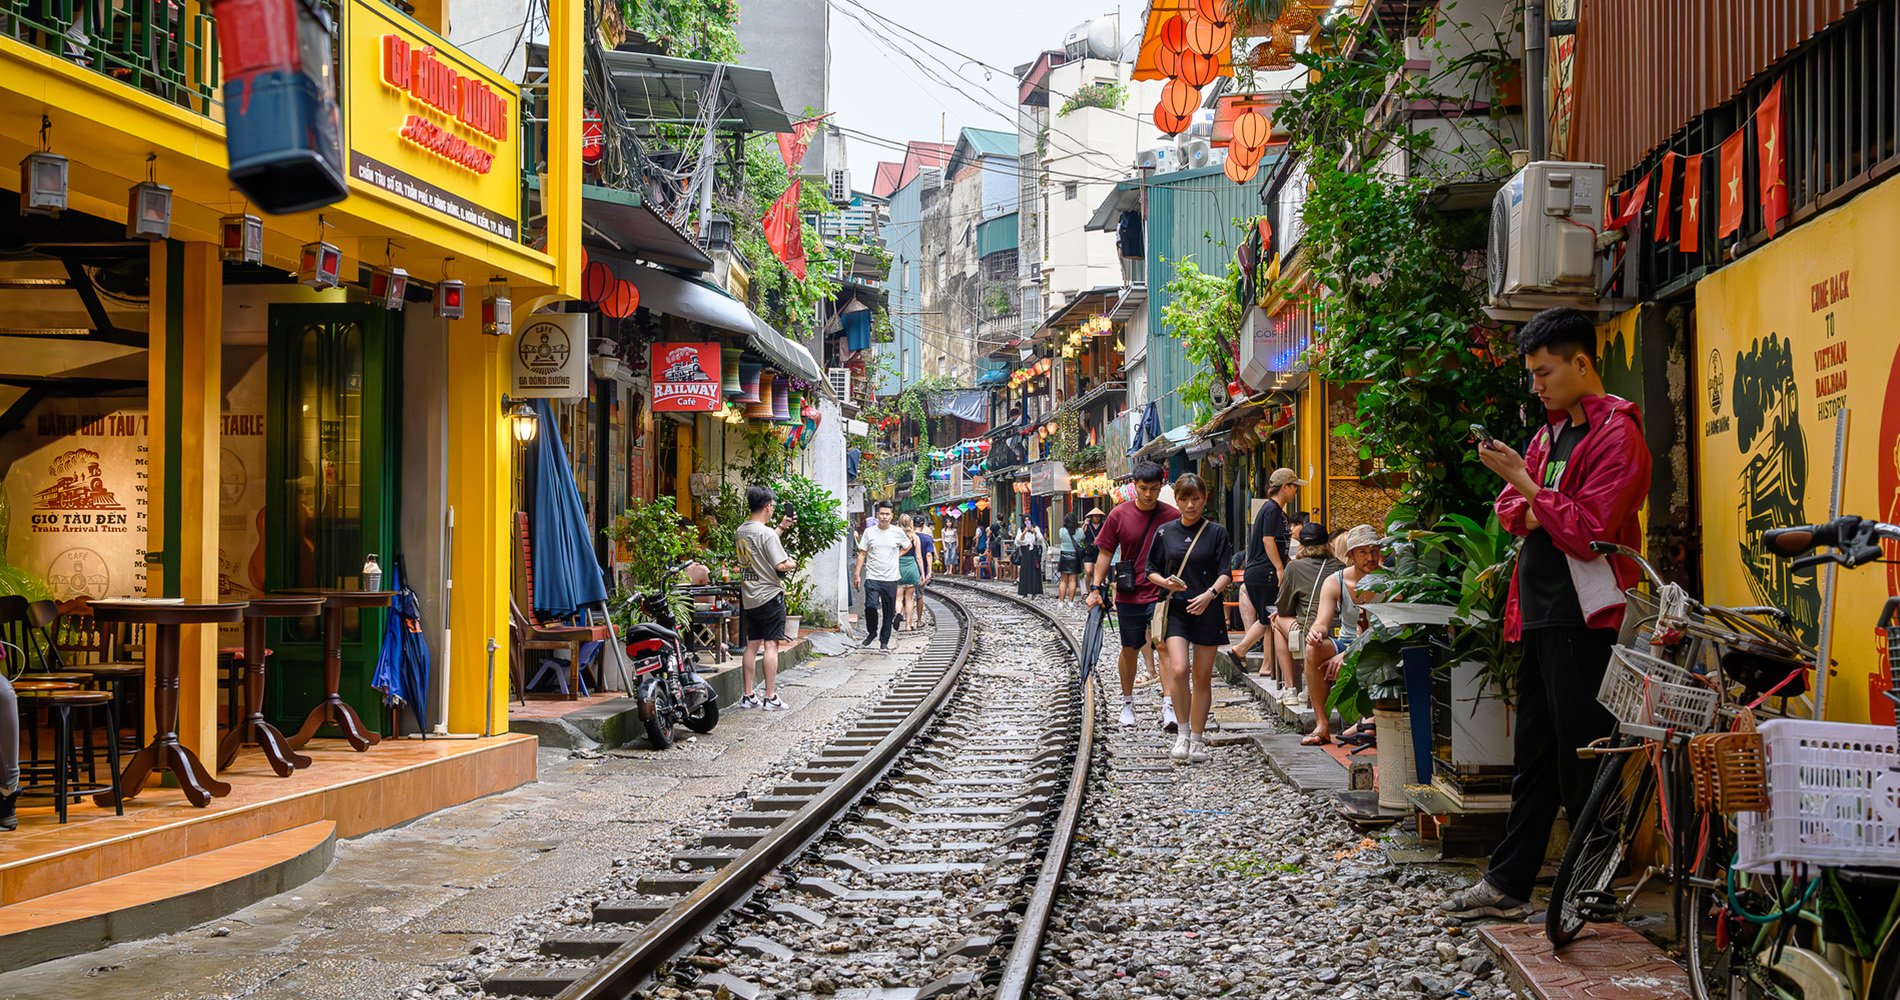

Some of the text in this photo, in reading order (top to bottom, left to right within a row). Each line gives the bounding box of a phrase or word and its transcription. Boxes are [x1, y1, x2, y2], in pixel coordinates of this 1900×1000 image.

[384, 35, 507, 142] GA ĐÔNG DƯƠNG
[1811, 270, 1849, 313] COME BACK
[1825, 312, 1835, 339] TO
[1814, 340, 1847, 372] VIETNAM
[519, 376, 528, 385] GA
[654, 384, 718, 399] RAILWAY
[1815, 369, 1847, 398] RAILROAD
[677, 397, 696, 406] Café
[31, 510, 127, 524] GIỜ TÀU ĐẾN
